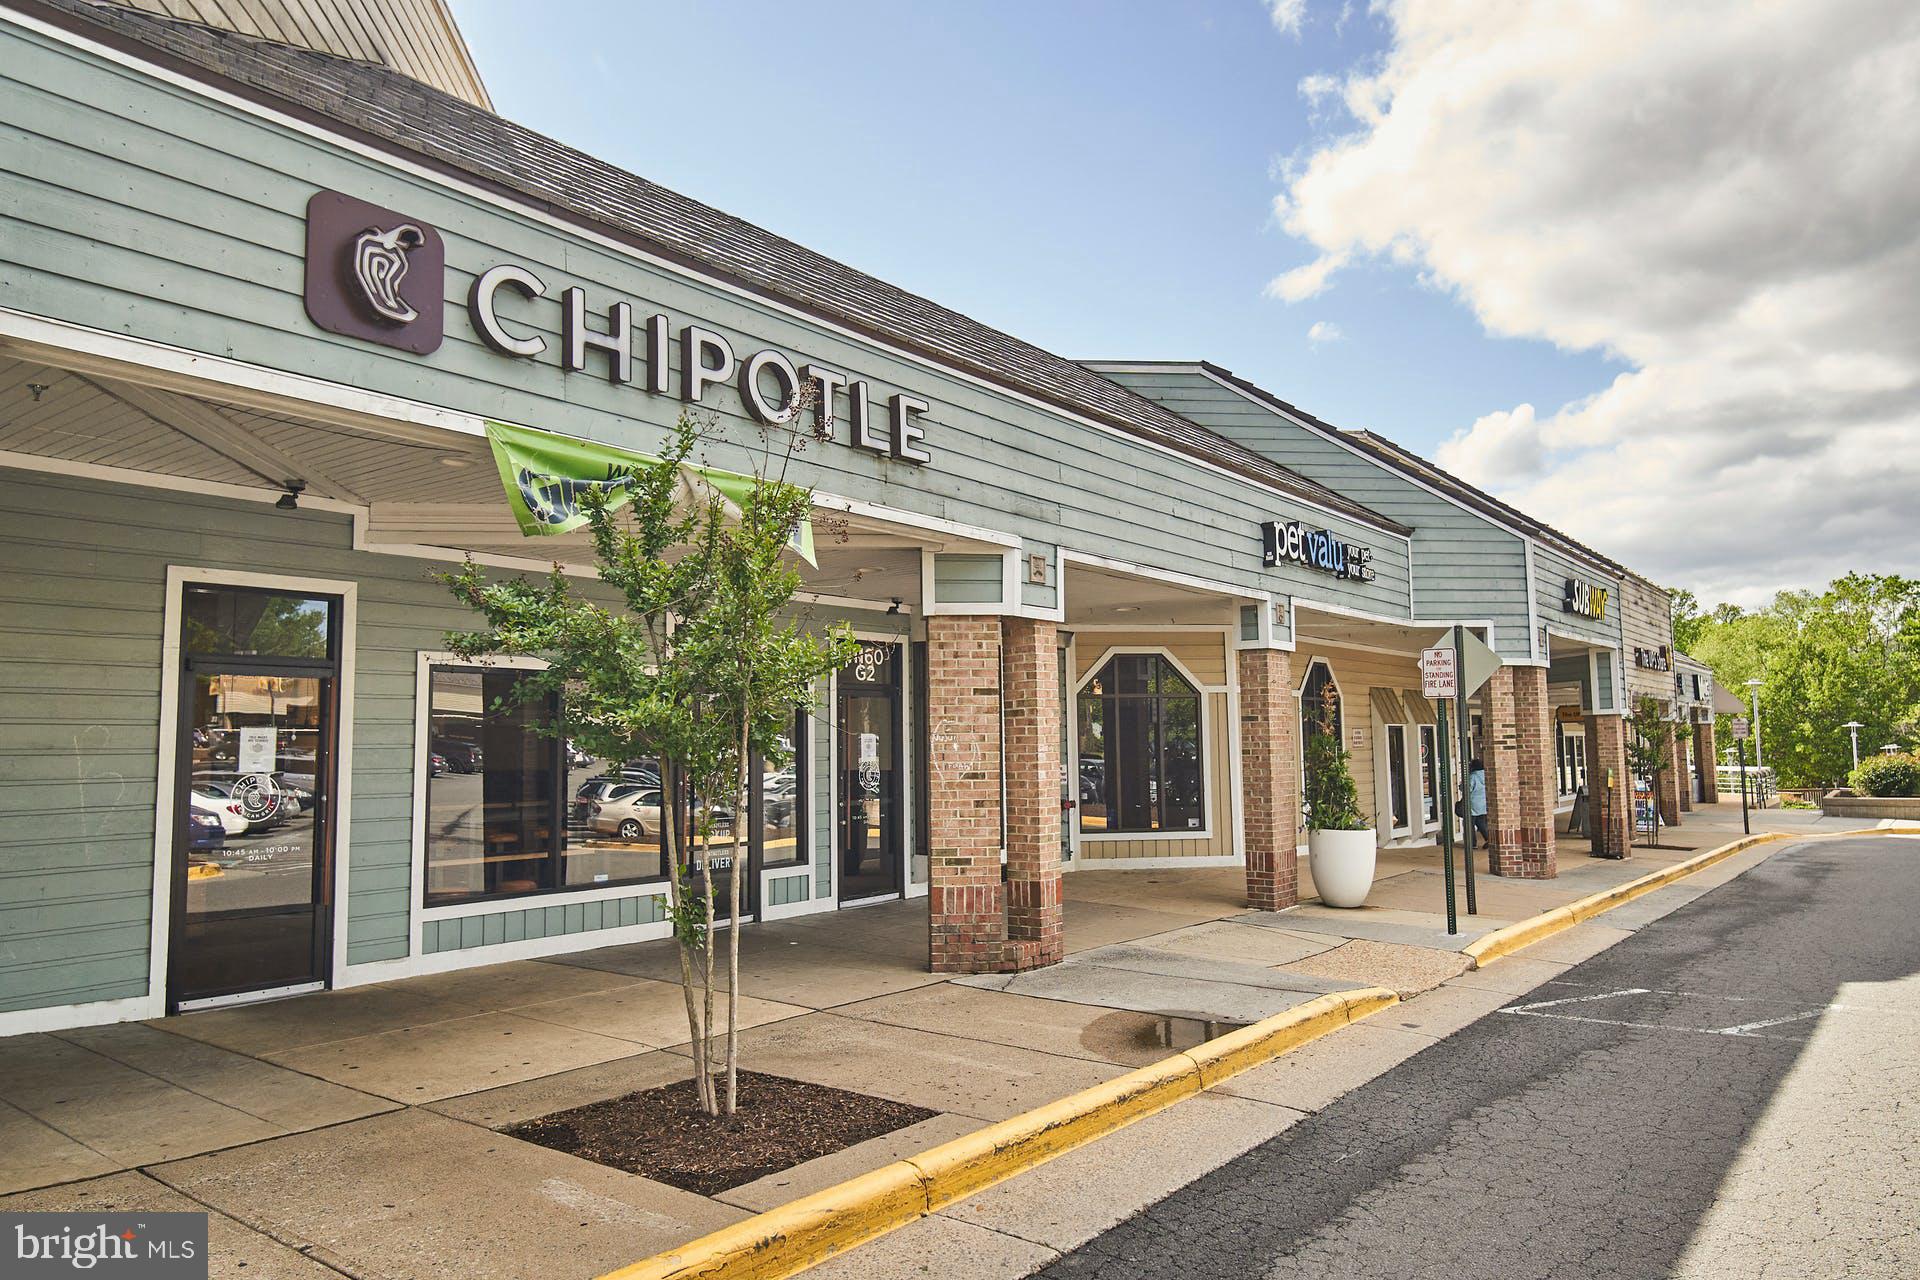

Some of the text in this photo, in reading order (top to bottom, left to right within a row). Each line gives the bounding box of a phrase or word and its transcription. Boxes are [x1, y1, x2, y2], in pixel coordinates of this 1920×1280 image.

[468, 264, 931, 464] CHIPOTLE
[1273, 521, 1345, 572] pet valu
[1347, 545, 1360, 560] your
[1347, 563, 1360, 578] your
[1572, 579, 1608, 620] SUBWAY
[856, 664, 876, 681] G2
[1439, 680, 1454, 688] LANE
[222, 849, 246, 857] 10:45
[249, 854, 273, 862] DAILY
